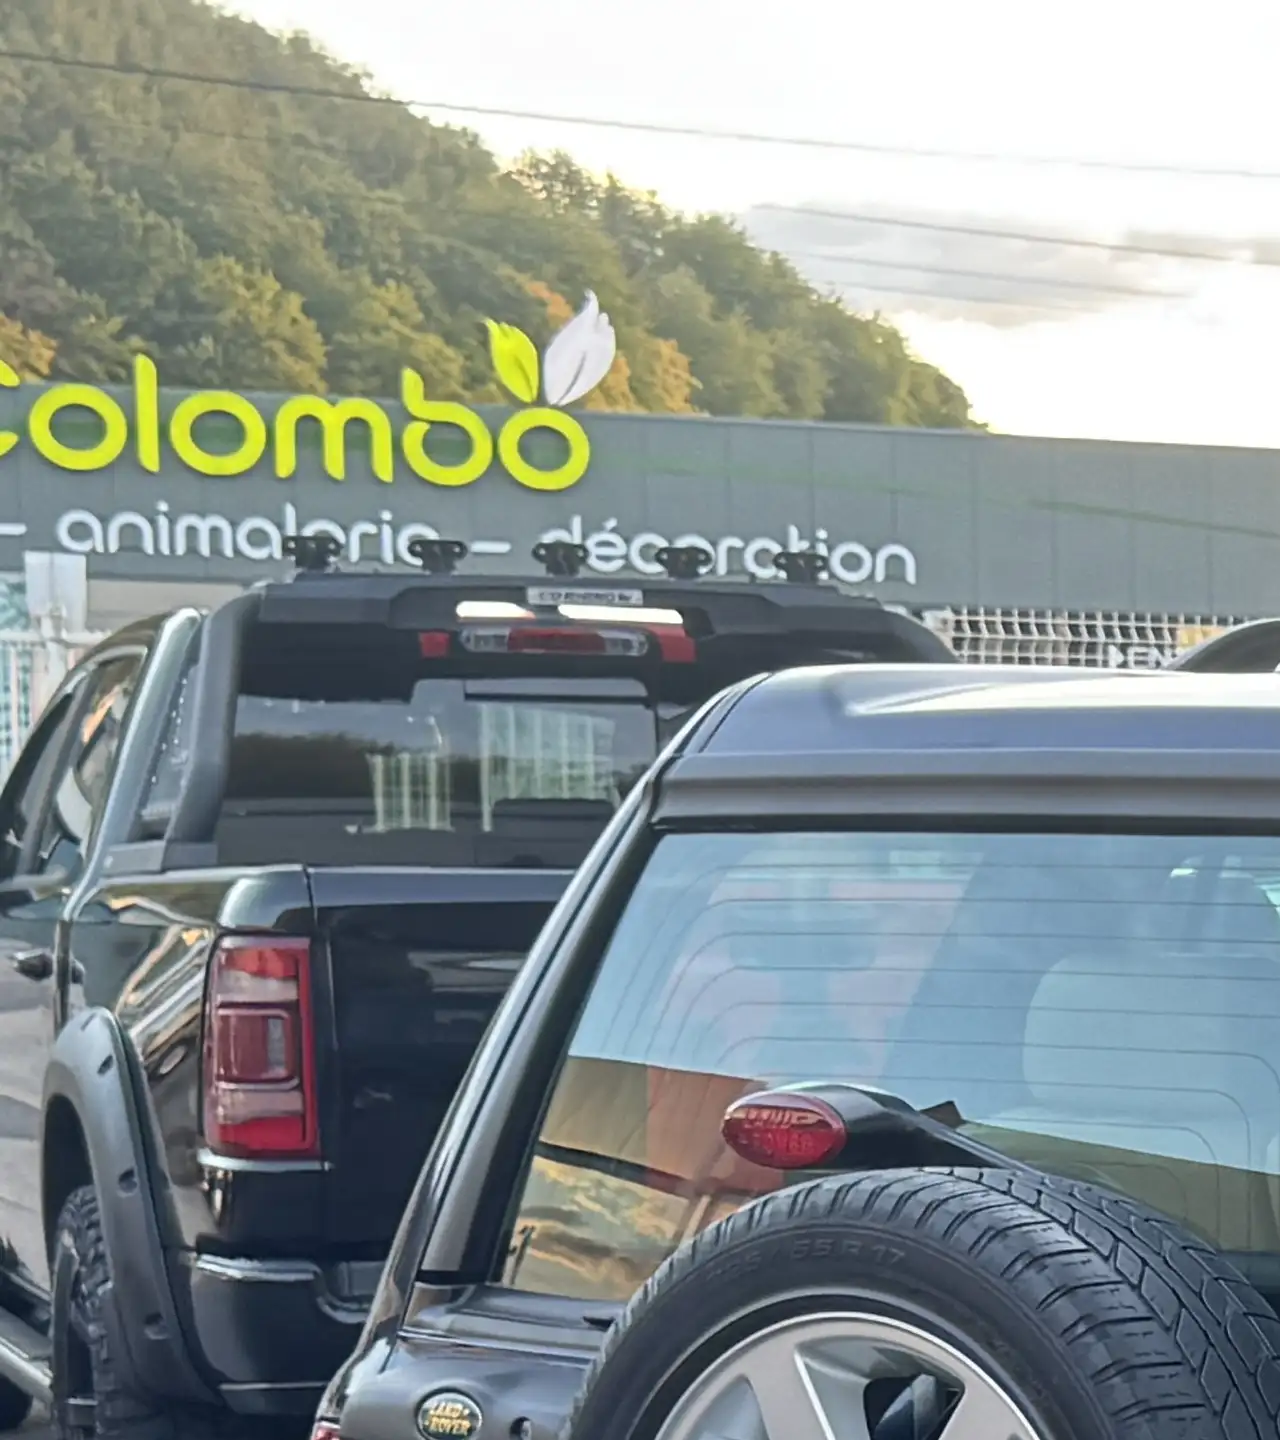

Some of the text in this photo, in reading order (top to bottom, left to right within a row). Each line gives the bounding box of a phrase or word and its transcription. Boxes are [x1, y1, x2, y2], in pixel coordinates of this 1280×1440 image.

[0, 353, 591, 490] olombo
[429, 1401, 463, 1418] LAND
[429, 1417, 471, 1436] ROVER
